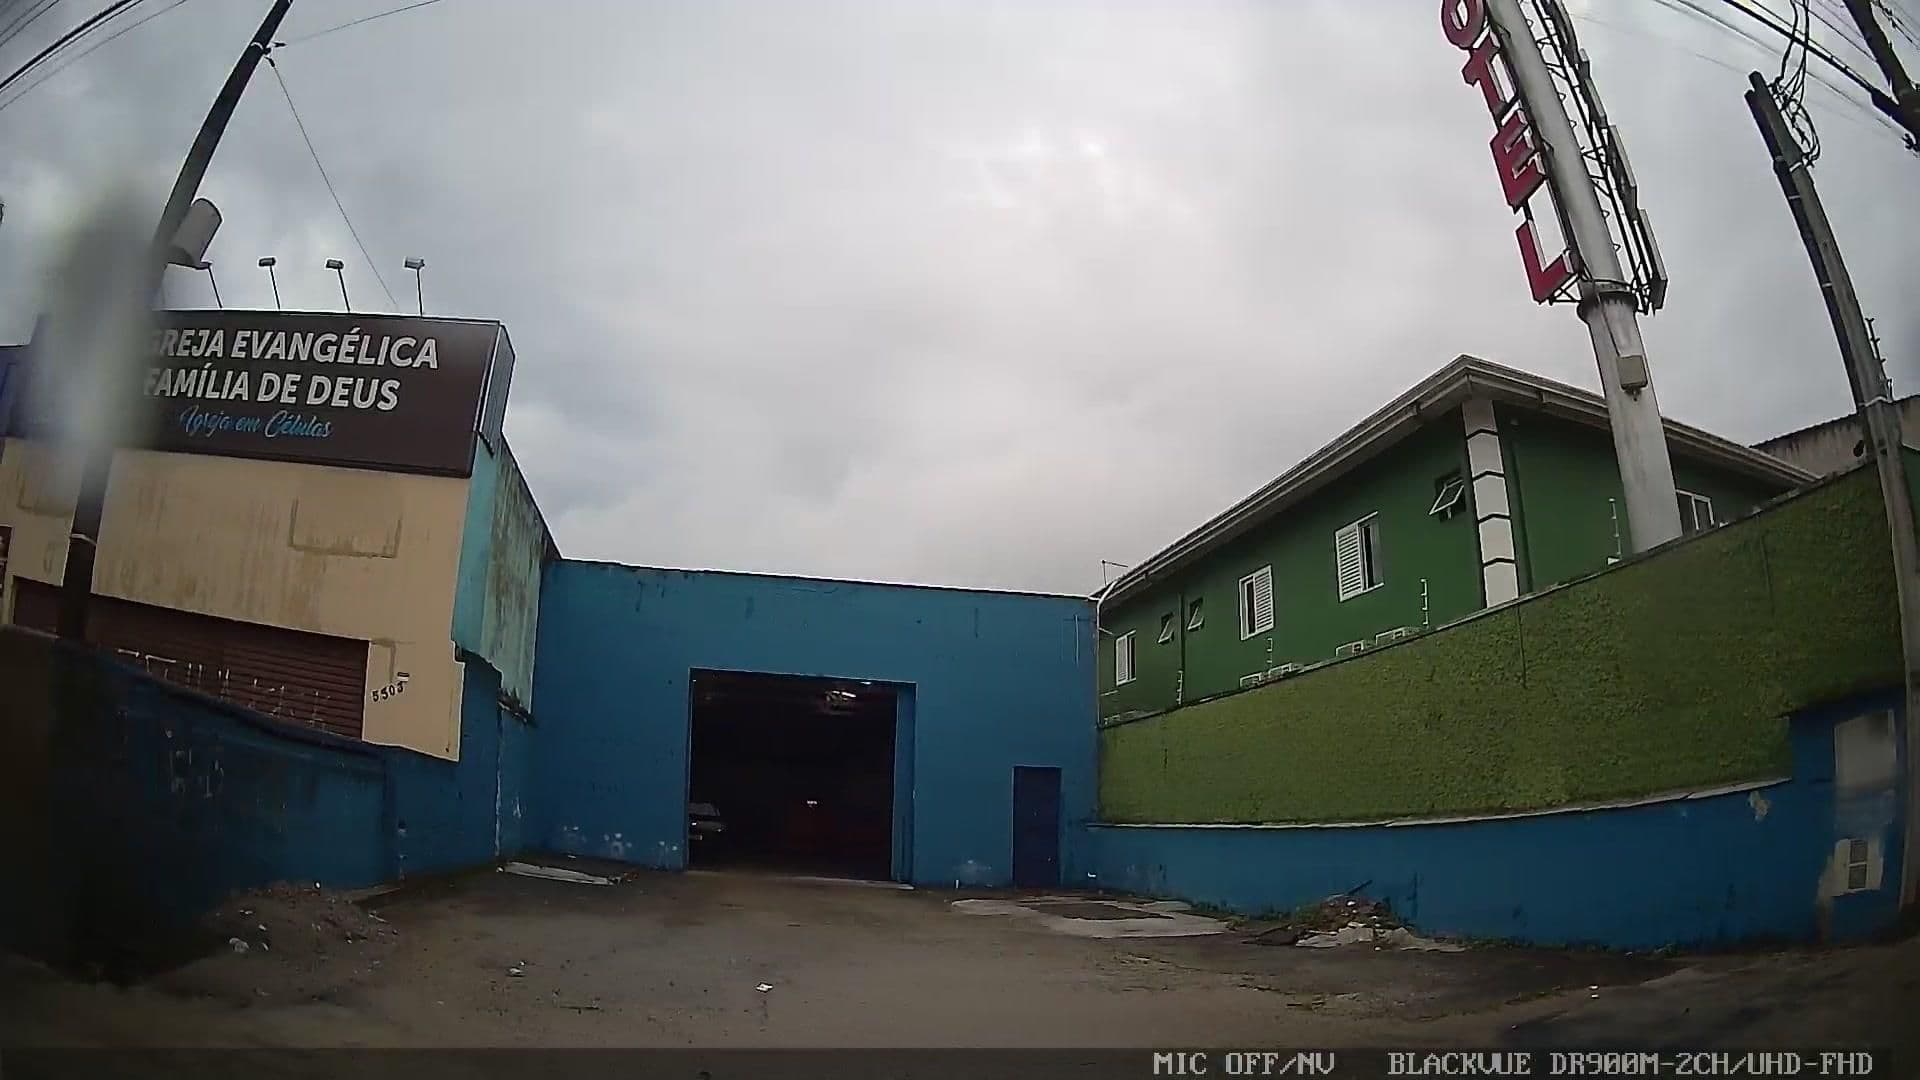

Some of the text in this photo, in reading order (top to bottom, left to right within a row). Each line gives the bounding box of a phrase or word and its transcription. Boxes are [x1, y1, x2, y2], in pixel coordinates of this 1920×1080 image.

[231, 327, 438, 369] EVANGÉLICA
[144, 362, 400, 411] FAMÍLIA DE DEUS
[235, 416, 261, 432] em
[265, 410, 333, 438] Células
